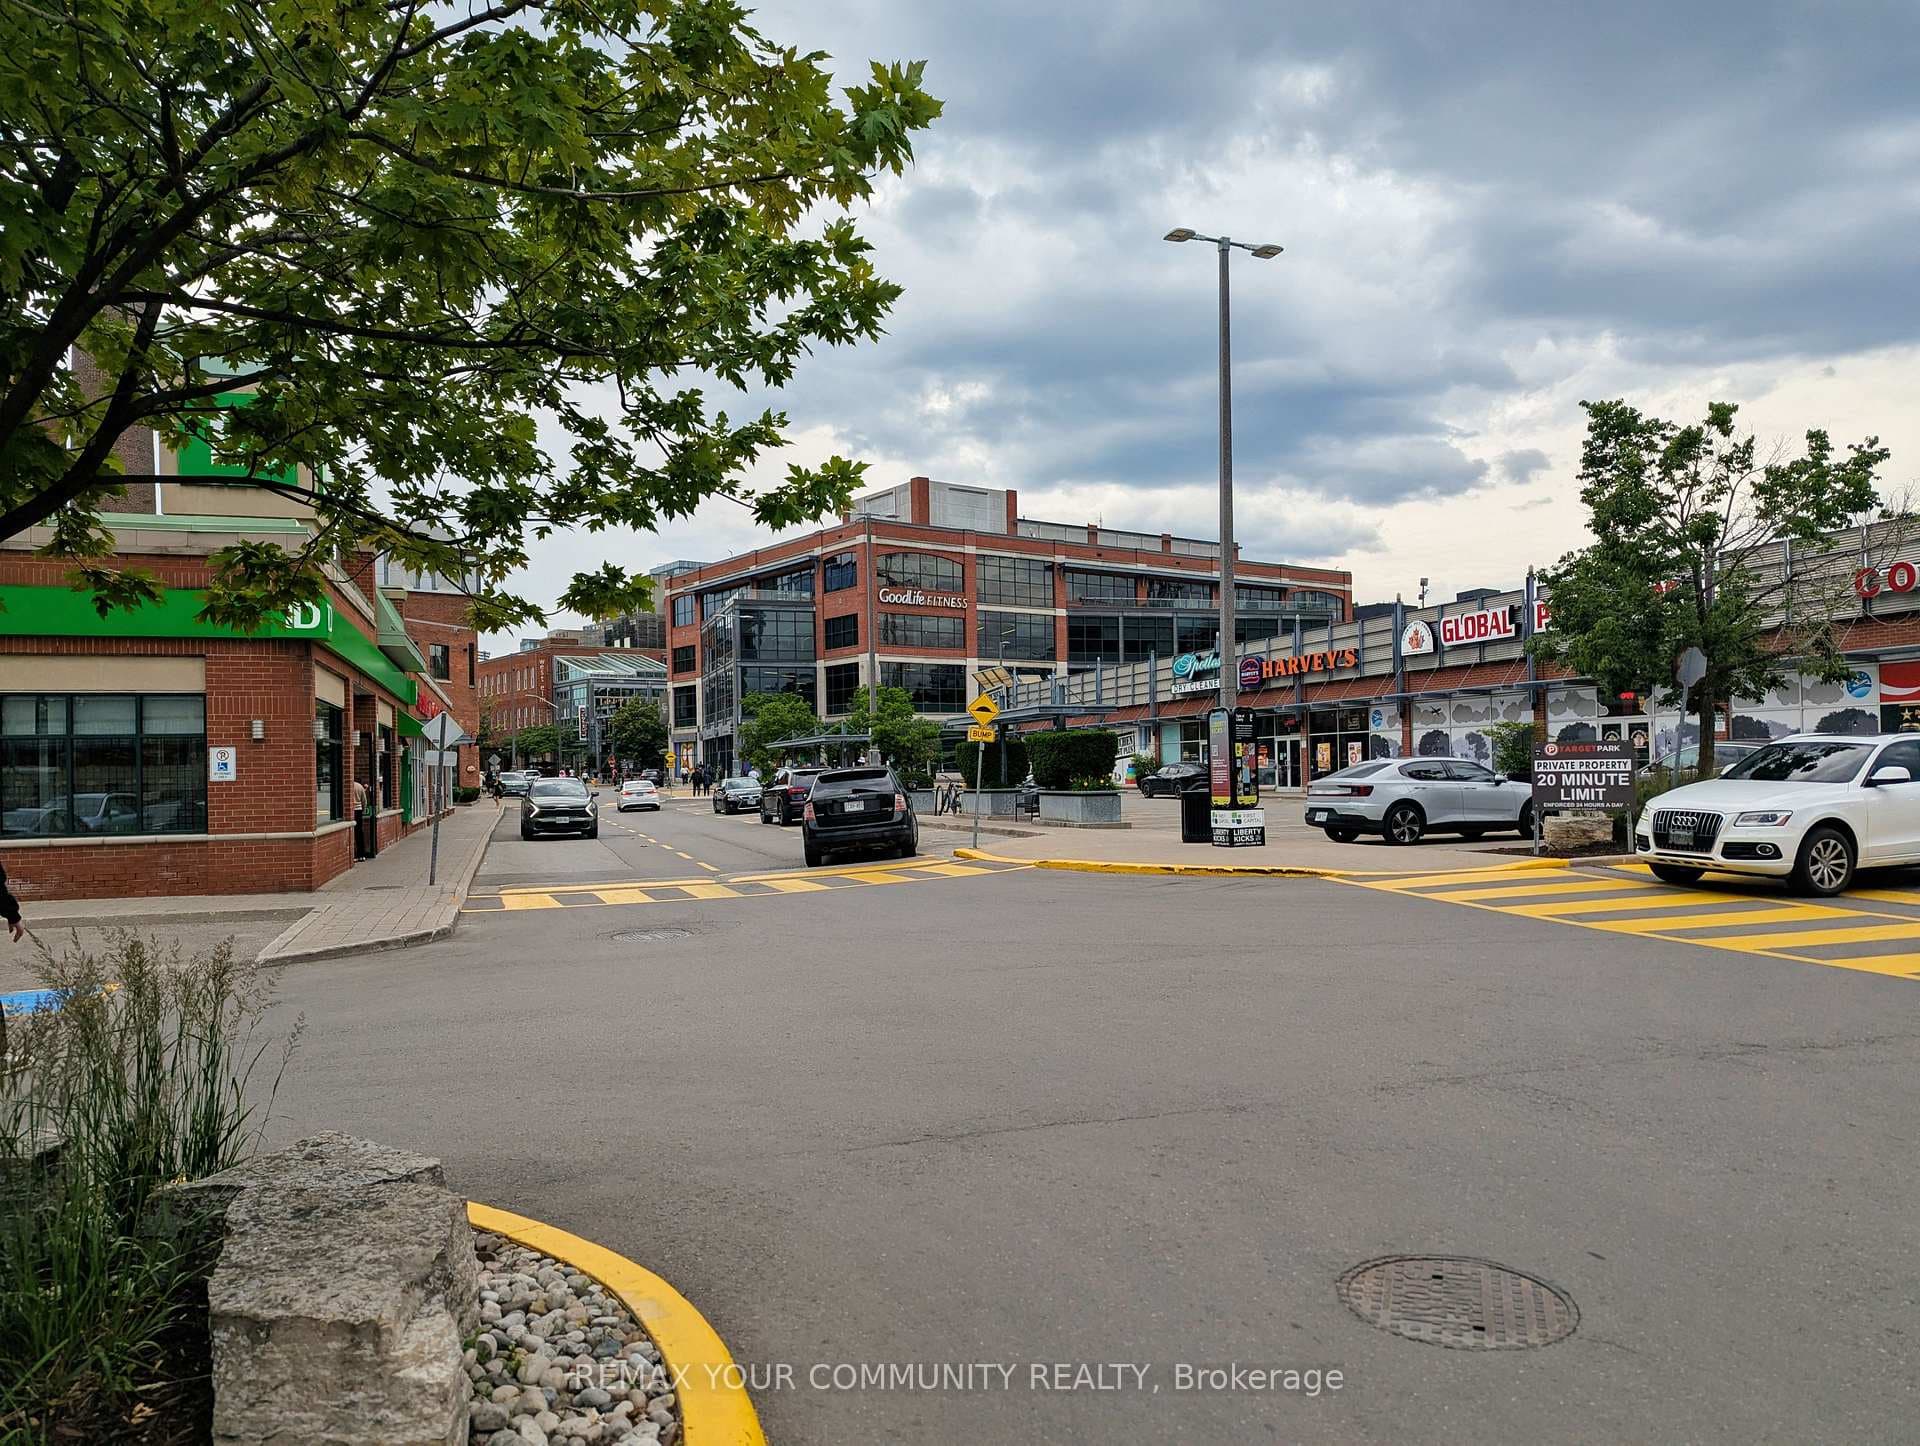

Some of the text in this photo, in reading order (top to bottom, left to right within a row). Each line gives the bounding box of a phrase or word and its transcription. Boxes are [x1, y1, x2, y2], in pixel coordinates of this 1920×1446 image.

[879, 588, 968, 608] GoodLife FITNESS
[1442, 610, 1512, 643] GLOBAL
[1262, 648, 1357, 679] HARVEY'S
[1537, 760, 1629, 770] PRIVATE PROPERTY
[1537, 773, 1630, 786] 20 MINUTE
[1560, 788, 1607, 800] LIMIT
[1234, 828, 1262, 836] LIBERTY
